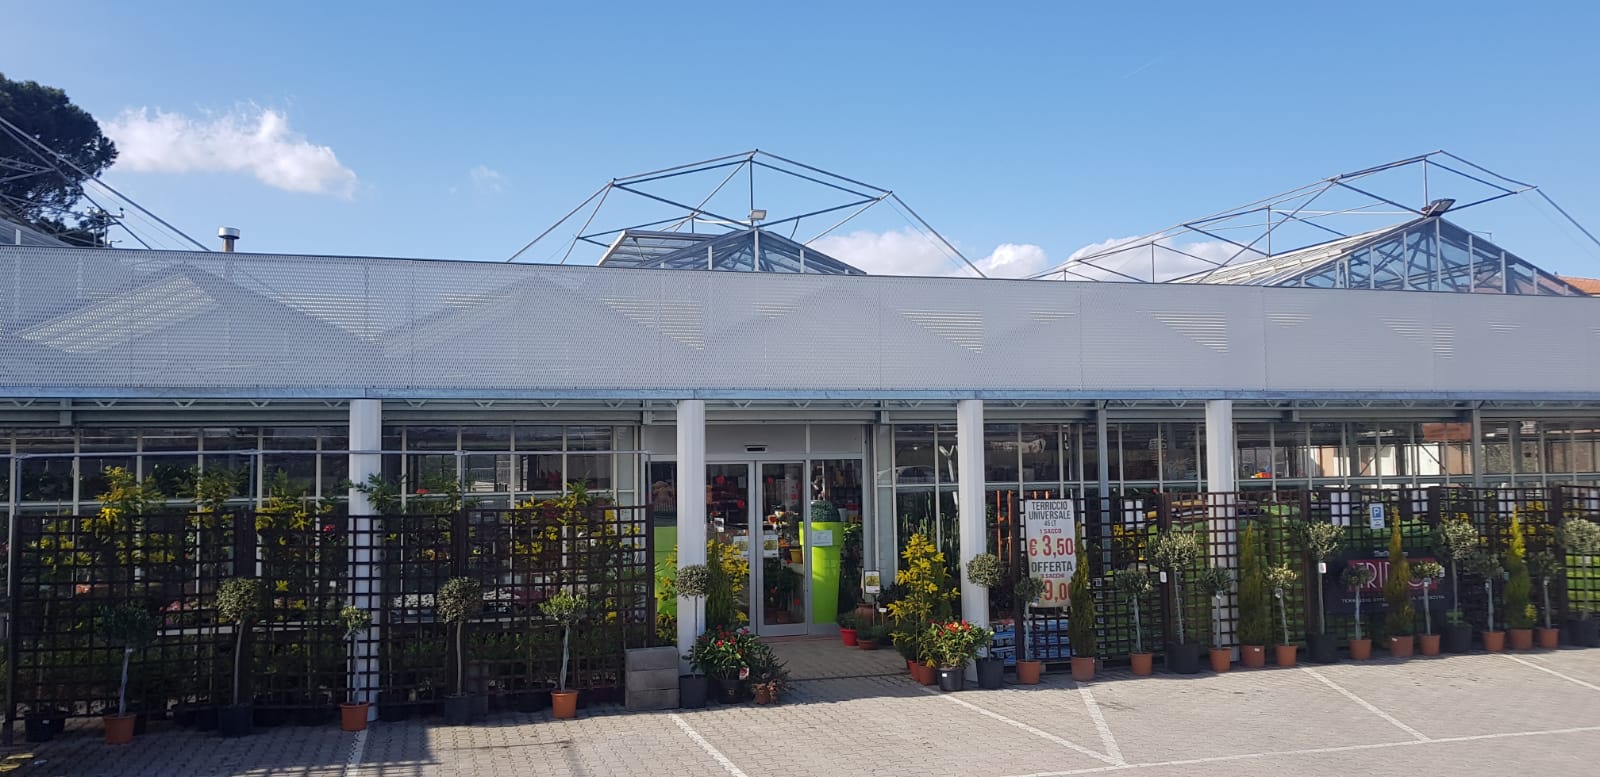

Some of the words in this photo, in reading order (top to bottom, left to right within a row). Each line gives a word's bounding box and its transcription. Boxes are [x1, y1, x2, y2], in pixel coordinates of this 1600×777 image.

[1031, 501, 1068, 510] TERRICCIO
[1028, 511, 1071, 520] UNIVERSALE
[1042, 535, 1074, 558] 3,50
[1031, 561, 1073, 573] OFFERTA
